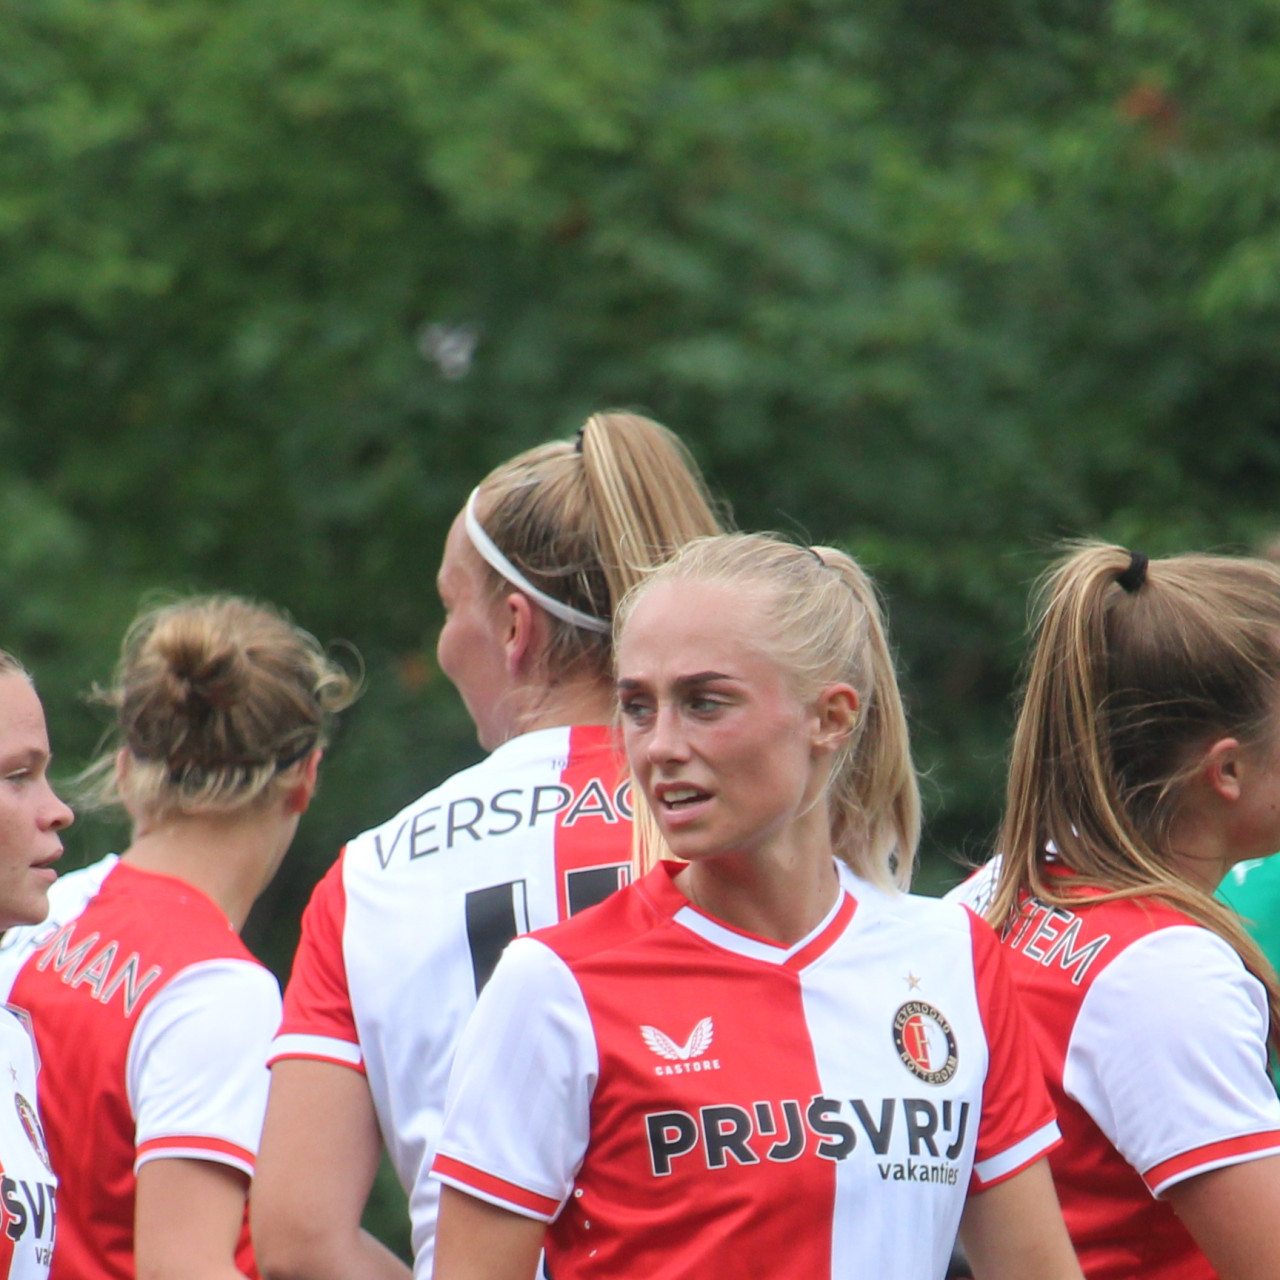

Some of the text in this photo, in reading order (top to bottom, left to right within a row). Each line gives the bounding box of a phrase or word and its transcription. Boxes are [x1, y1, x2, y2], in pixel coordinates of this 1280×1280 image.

[893, 1002, 951, 1034] FEYENOORD
[655, 1059, 720, 1076] CASTORE
[899, 1052, 958, 1085] ROTTERDAM
[644, 1095, 969, 1177] PRIJSVRIJ
[878, 1159, 958, 1186] vakanties
